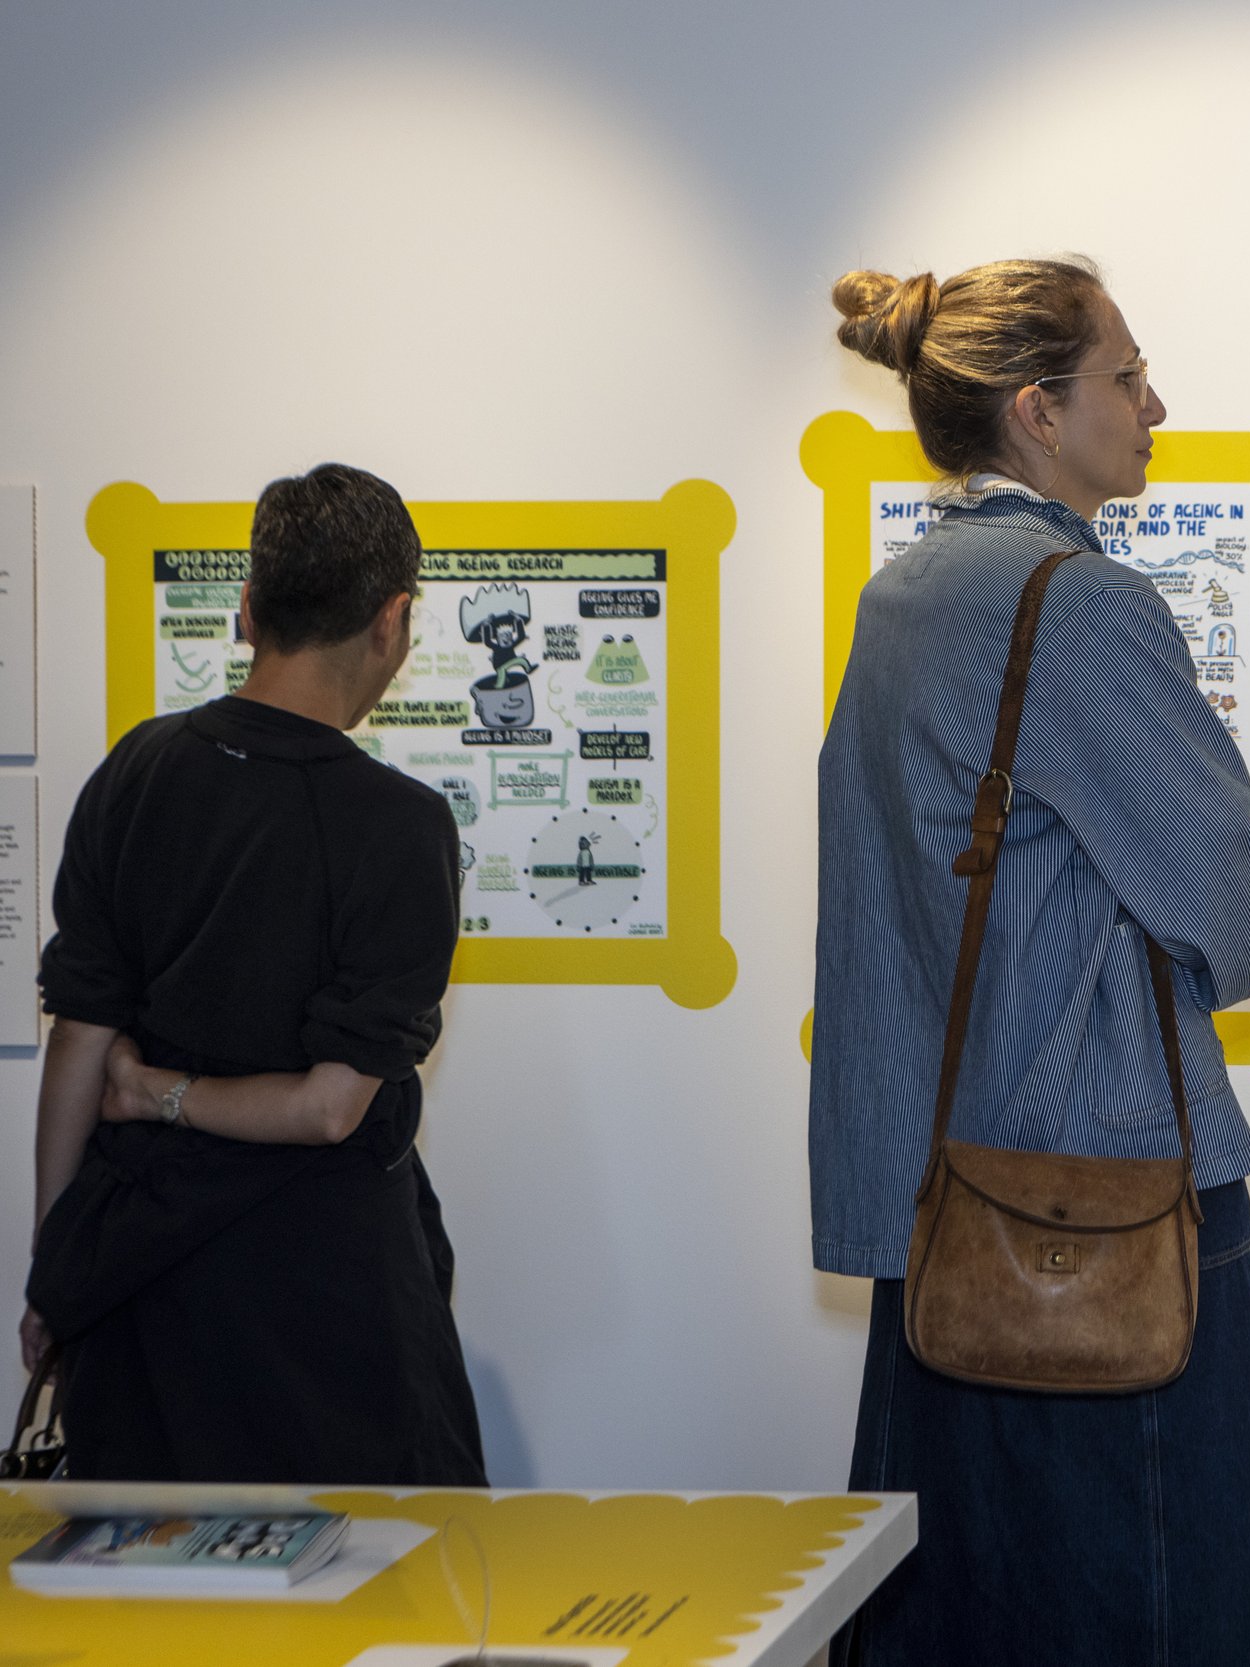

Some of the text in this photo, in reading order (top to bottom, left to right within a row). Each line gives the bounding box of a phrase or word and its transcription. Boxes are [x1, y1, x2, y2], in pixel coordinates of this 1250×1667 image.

[1101, 503, 1138, 519] IONS
[1148, 503, 1166, 518] OF
[1230, 504, 1243, 519] IN
[1137, 521, 1170, 536] AND
[1177, 520, 1206, 536] THE
